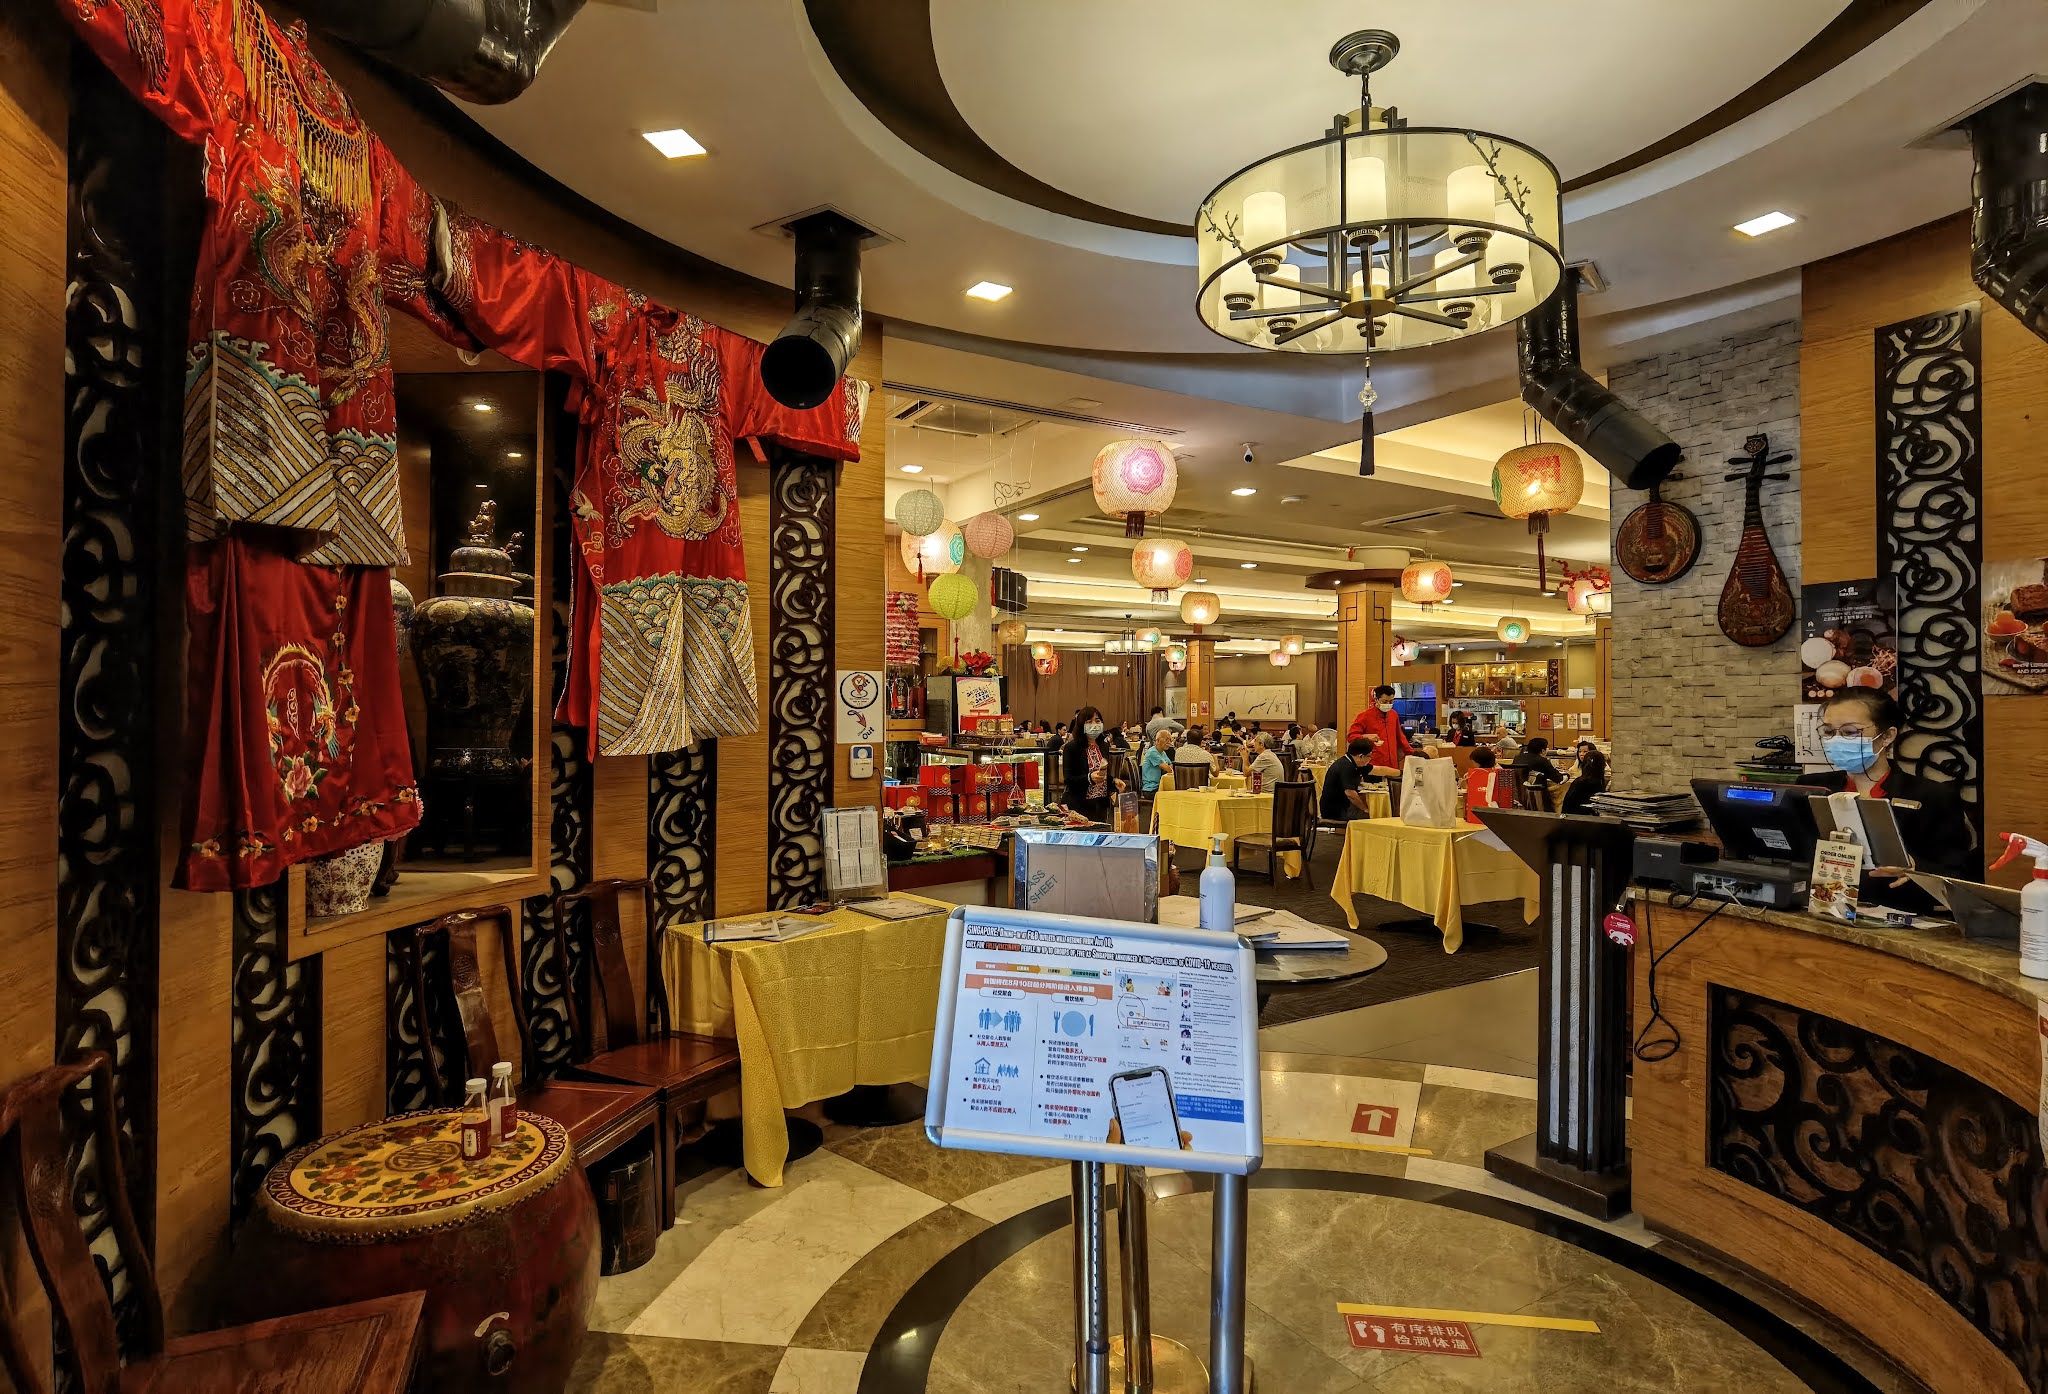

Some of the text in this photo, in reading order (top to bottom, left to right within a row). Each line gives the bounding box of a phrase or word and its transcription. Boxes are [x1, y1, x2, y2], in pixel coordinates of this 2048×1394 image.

[858, 679, 870, 691] Out
[862, 726, 875, 740] Out
[1837, 853, 1856, 861] ONLINE
[1030, 874, 1058, 904] SHEET
[967, 924, 999, 937] SINGAPORE:
[1027, 930, 1039, 940] F&B
[1021, 944, 1035, 953] PEOPLE
[1184, 956, 1211, 970] COVID-19
[1390, 1322, 1464, 1338] 有序排队
[1393, 1334, 1471, 1350] 检测体温
